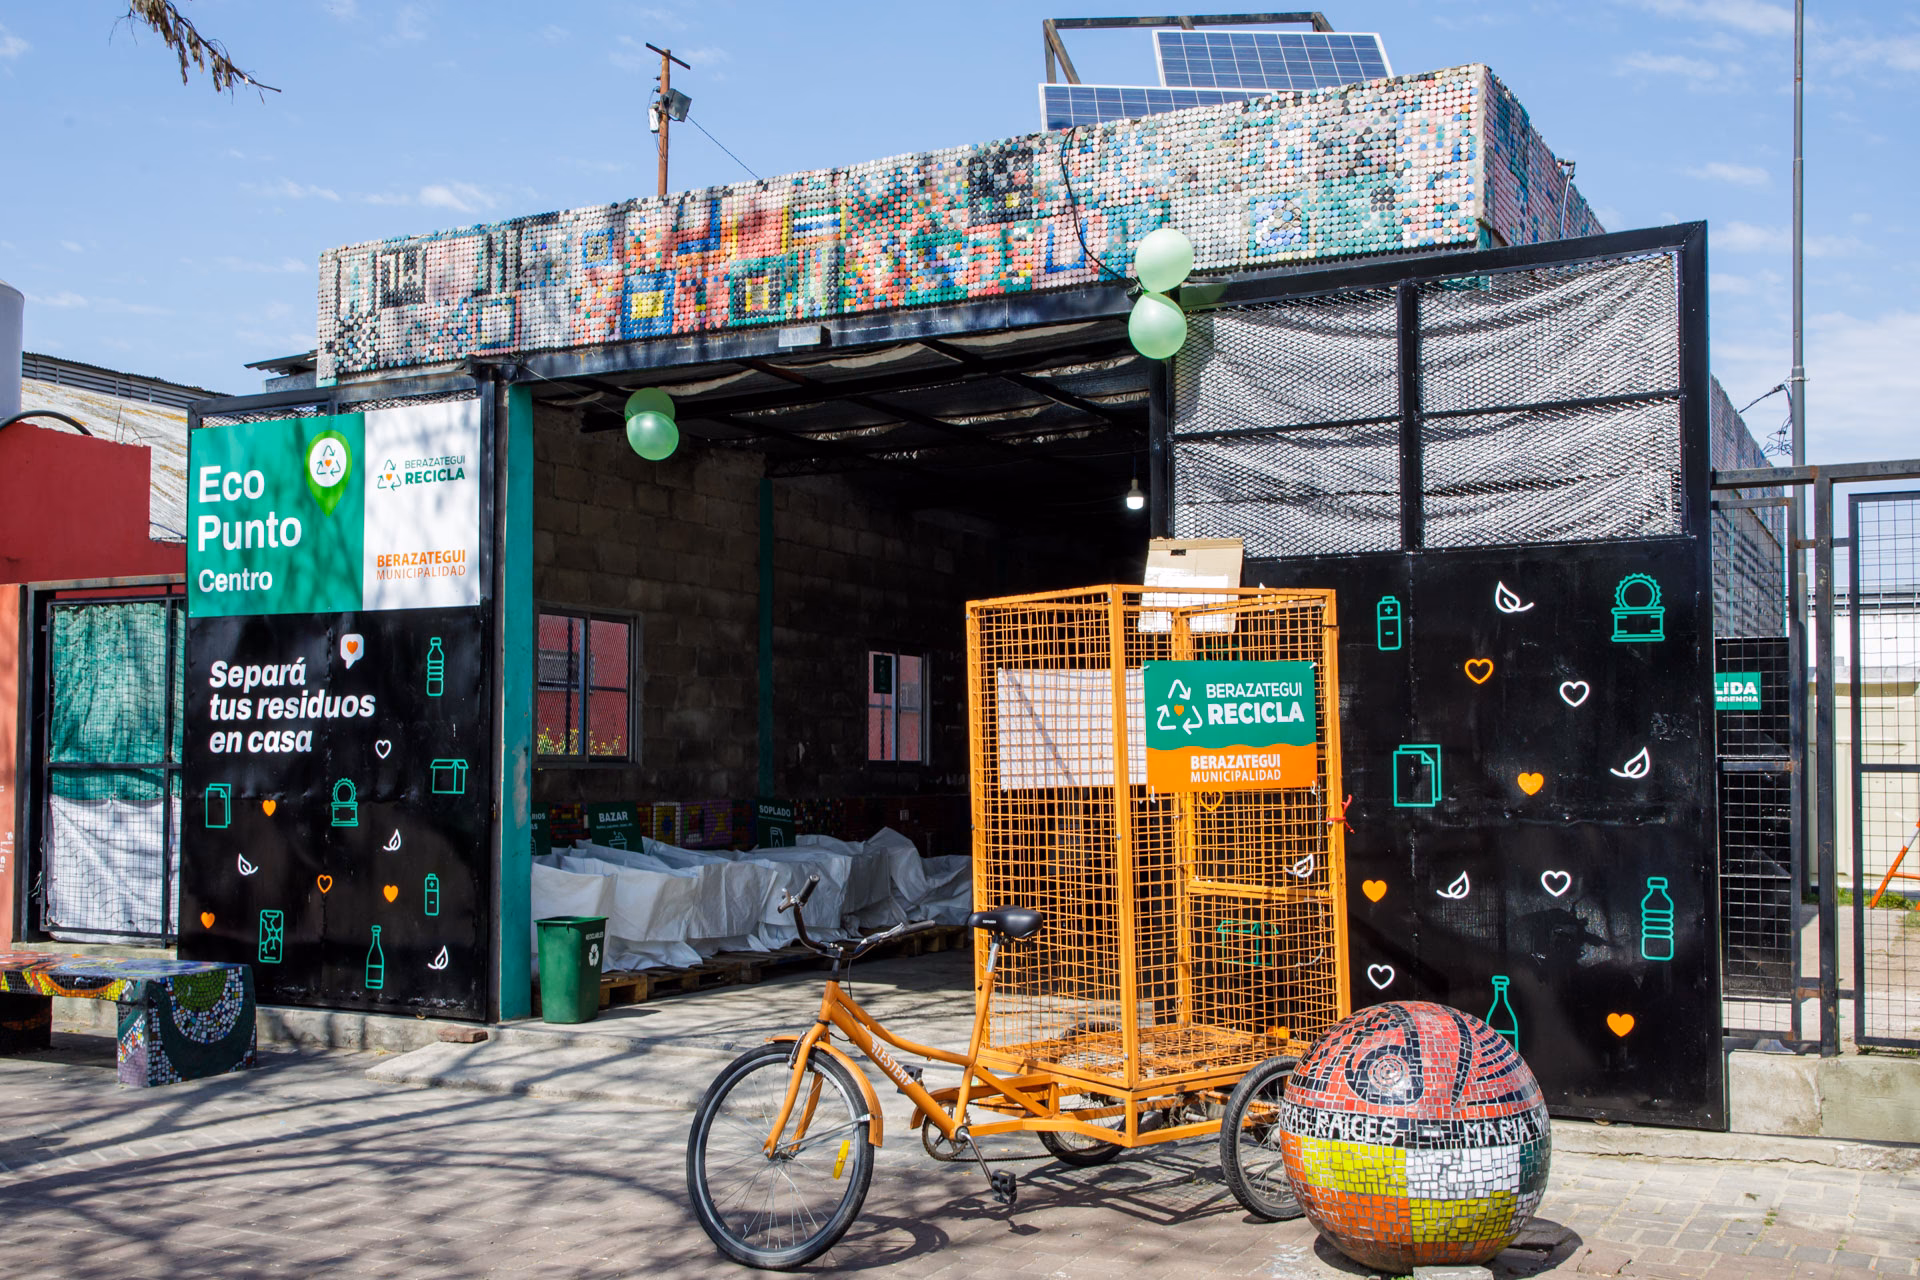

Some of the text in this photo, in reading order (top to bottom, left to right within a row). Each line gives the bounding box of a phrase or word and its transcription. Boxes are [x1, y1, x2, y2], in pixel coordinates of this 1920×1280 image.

[404, 456, 466, 469] BERAZATEGUI
[198, 465, 265, 503] Eco
[404, 469, 466, 485] RECICLA
[197, 511, 302, 552] Punto
[377, 549, 466, 568] BERAZATEGUI
[198, 568, 273, 593] Centro
[376, 567, 466, 580] MUNICIPALIDAD
[210, 657, 306, 693] Separá
[1206, 682, 1303, 699] BERAZATEGUI
[1714, 681, 1758, 695] LIDA
[210, 690, 376, 720] tus residuos
[1716, 695, 1758, 703] RGENCIA
[1207, 701, 1305, 725] RECICLA
[210, 730, 312, 753] en casa
[1190, 754, 1281, 770] BERAZATEGUI
[1190, 769, 1281, 783] MUNICIPALIDAD
[598, 811, 629, 823] BAZAR
[759, 805, 791, 818] SOPLADO
[874, 1045, 910, 1085] LESTER
[1316, 1109, 1396, 1144] RAICES
[1464, 1117, 1533, 1147] MARIA
